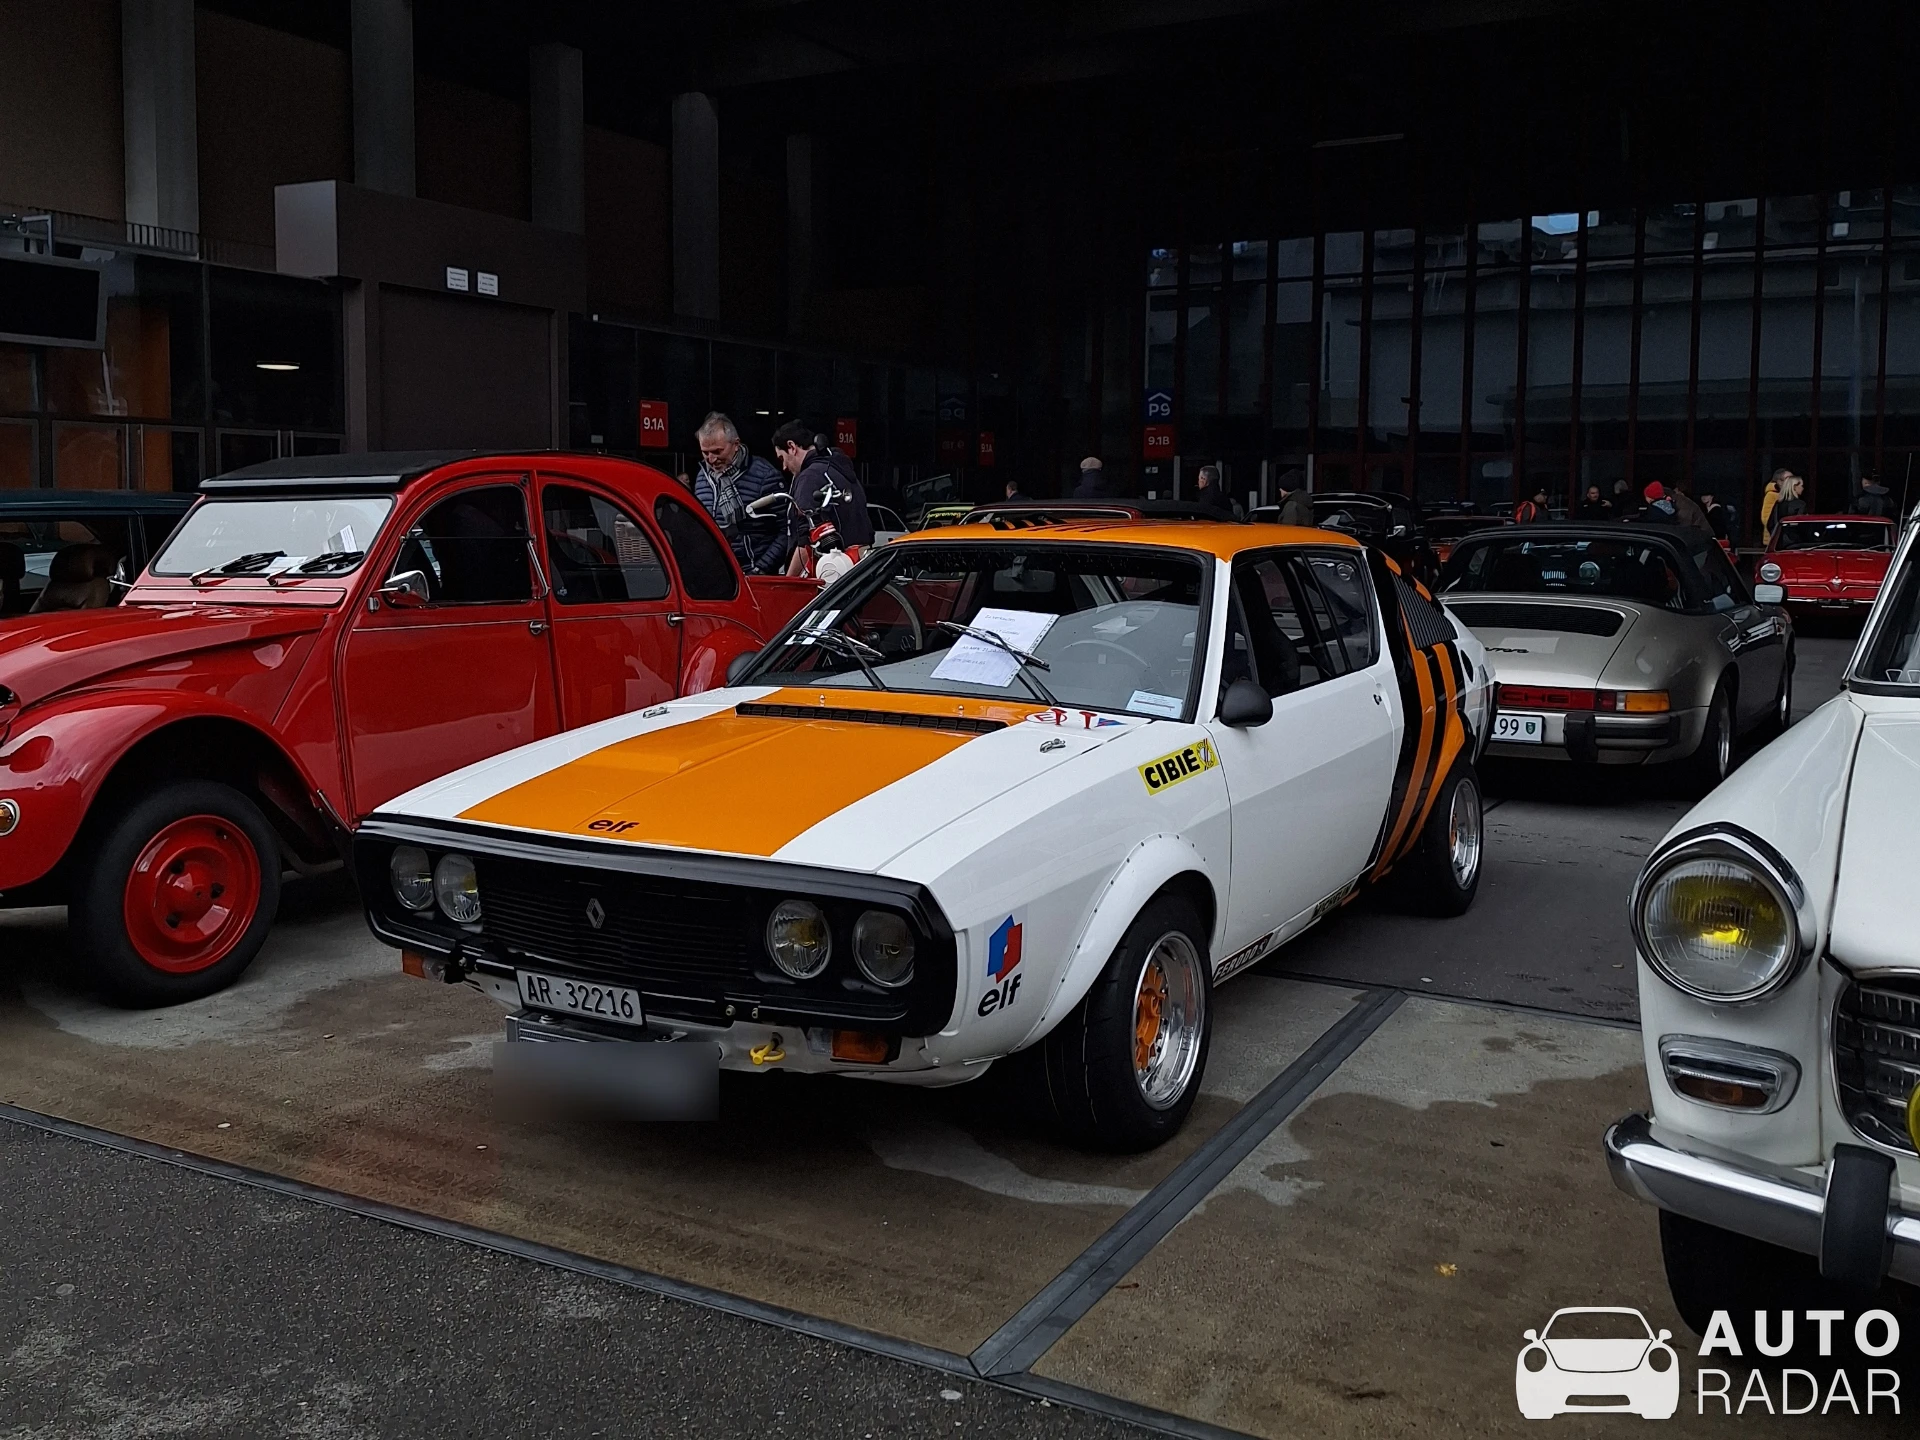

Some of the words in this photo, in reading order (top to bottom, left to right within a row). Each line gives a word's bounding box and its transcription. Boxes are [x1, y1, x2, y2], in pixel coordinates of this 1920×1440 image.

[1148, 403, 1171, 417] P9
[643, 416, 665, 431] 9.1A
[838, 432, 854, 444] 9.1A
[1147, 435, 1170, 446] 9.1B
[588, 819, 640, 833] elf
[977, 973, 1022, 1017] elf
